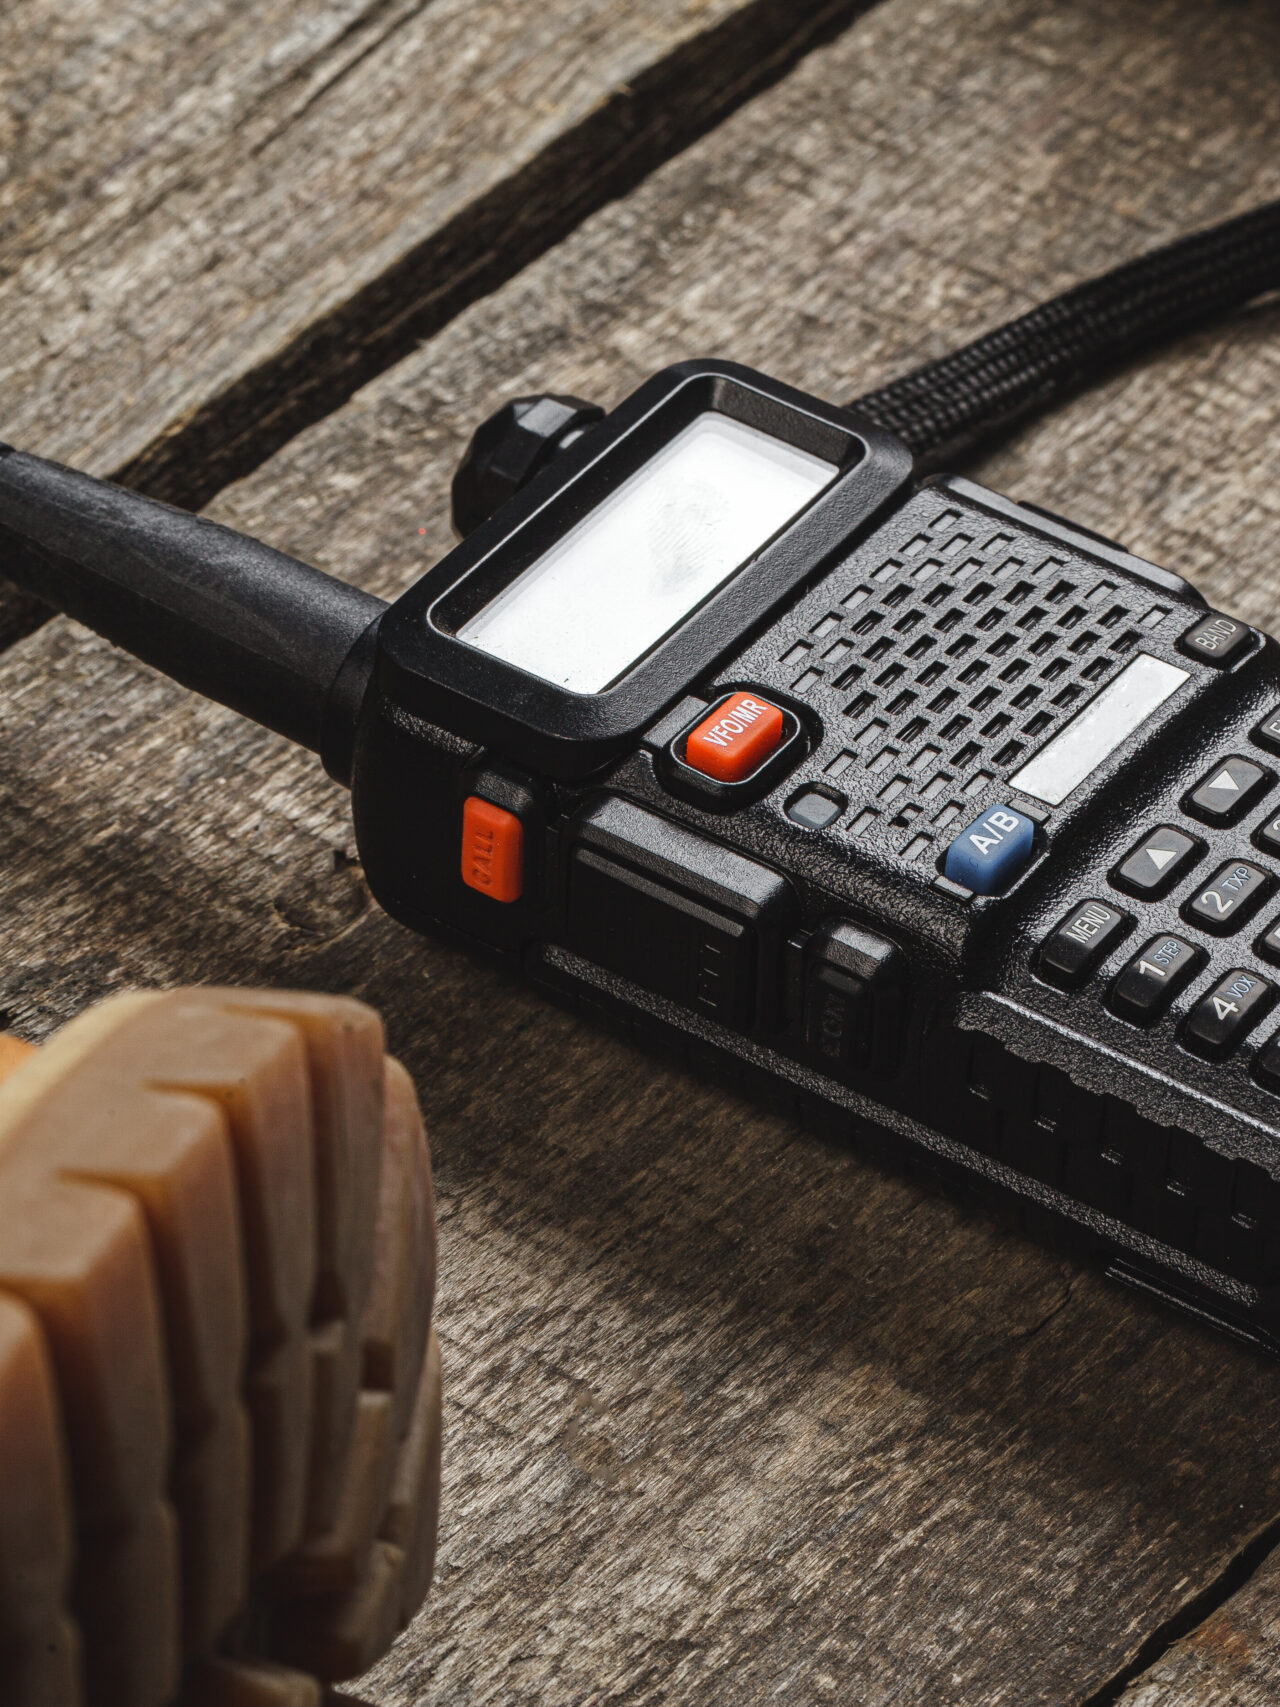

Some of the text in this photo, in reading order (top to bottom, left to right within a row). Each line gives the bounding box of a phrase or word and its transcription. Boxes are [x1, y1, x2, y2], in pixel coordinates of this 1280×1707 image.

[1195, 619, 1237, 651] BAND
[703, 698, 767, 749] VFO/MR
[968, 811, 1020, 855] A/B
[472, 830, 494, 886] CALL
[1201, 867, 1251, 914] 2 TXP
[1066, 906, 1111, 945] MENU
[1139, 940, 1182, 977] 1 STEP
[1212, 975, 1257, 1021] 4 VOX
